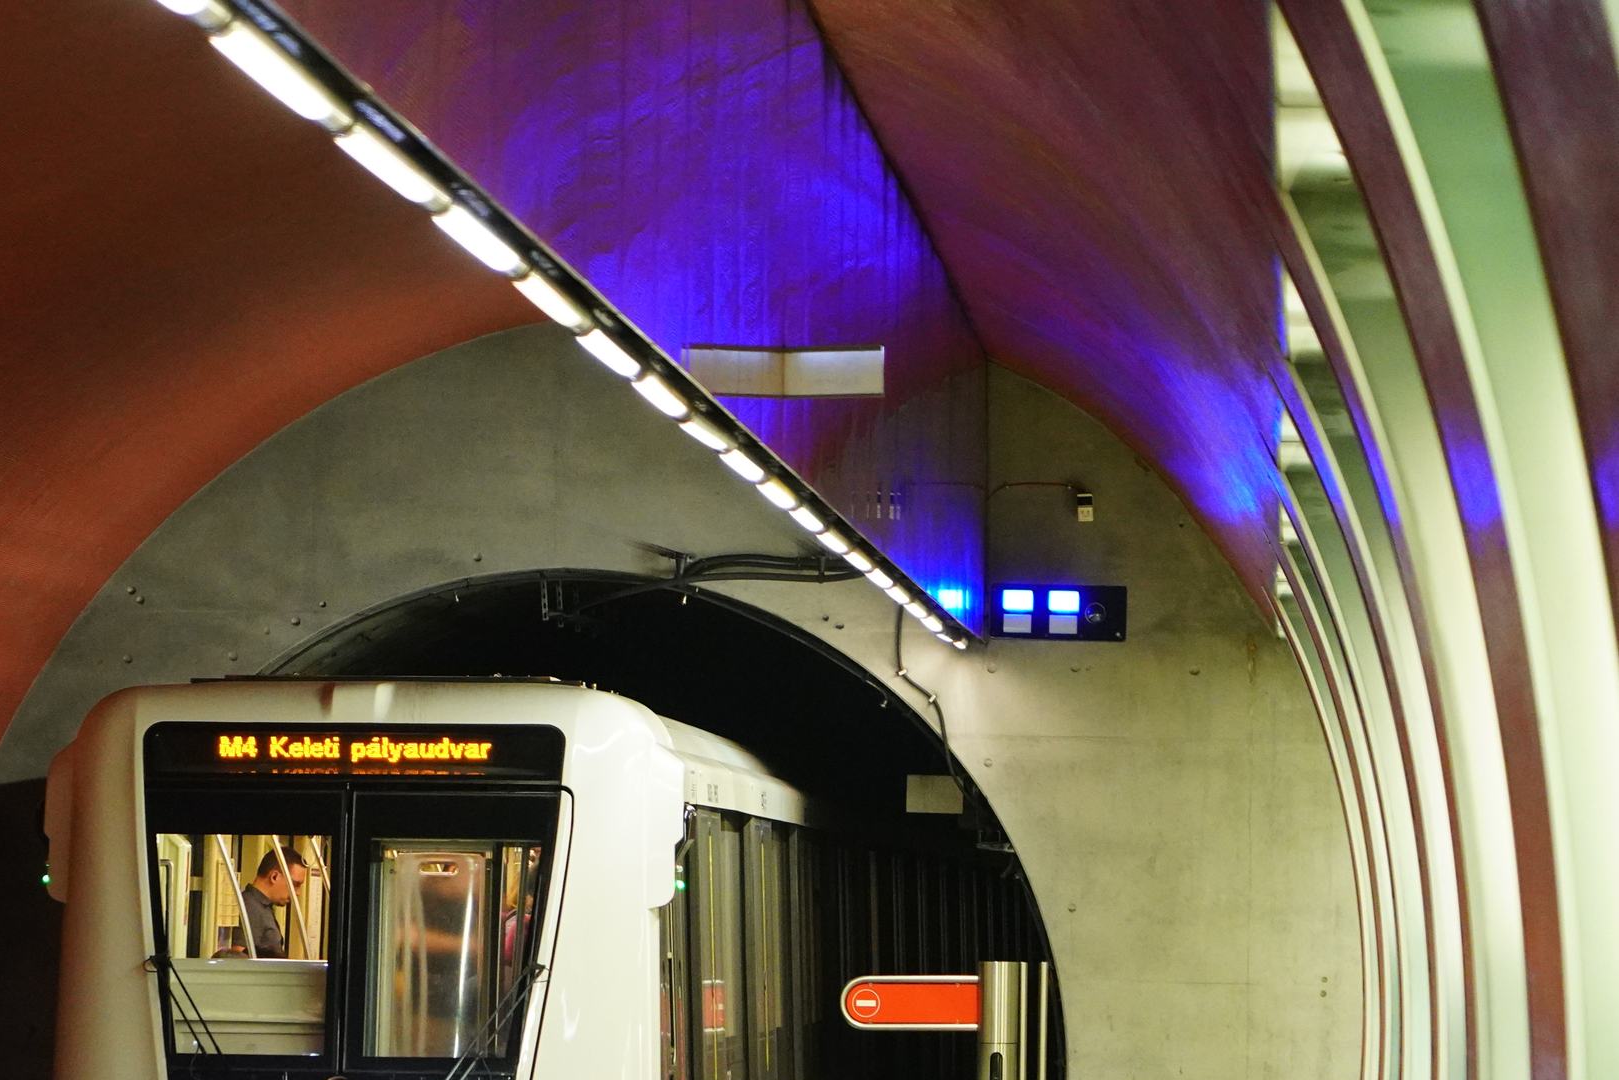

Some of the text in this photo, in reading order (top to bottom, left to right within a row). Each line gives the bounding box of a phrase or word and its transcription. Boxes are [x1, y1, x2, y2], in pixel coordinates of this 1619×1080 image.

[219, 735, 493, 763] M4 Keleti pályaudvar
